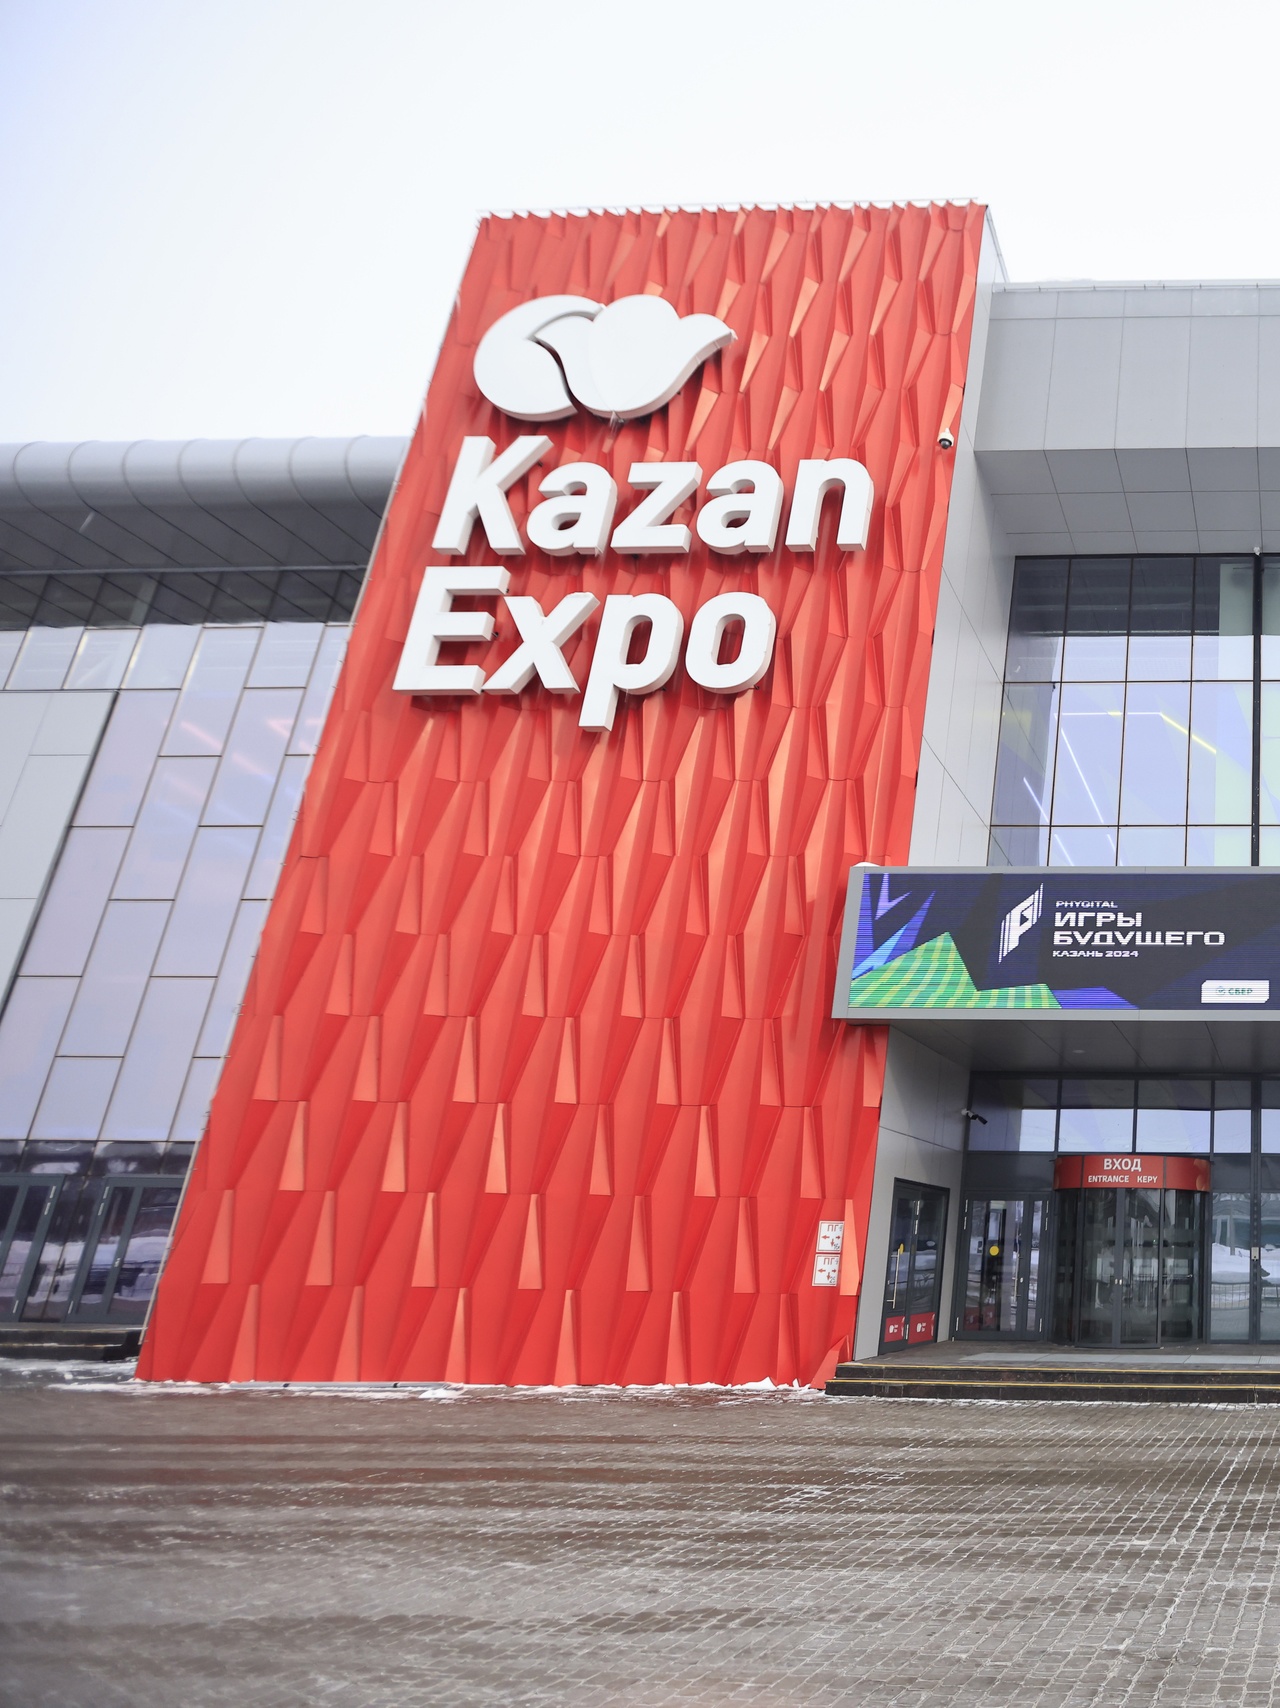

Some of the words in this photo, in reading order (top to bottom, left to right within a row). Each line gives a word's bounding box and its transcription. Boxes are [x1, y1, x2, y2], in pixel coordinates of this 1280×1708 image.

[431, 434, 875, 557] Kazan
[391, 565, 777, 733] Expo
[1055, 900, 1118, 909] PHYGITAL
[1054, 911, 1143, 927] ИГРЫ
[1052, 930, 1226, 946] БУДУЩЕГО
[1052, 950, 1104, 958] КАЗАНЬ
[1105, 950, 1139, 958] 2024
[1228, 987, 1253, 996] СБЕР
[1103, 1158, 1142, 1172] ВХОД
[1088, 1175, 1129, 1183] ENTRANCE
